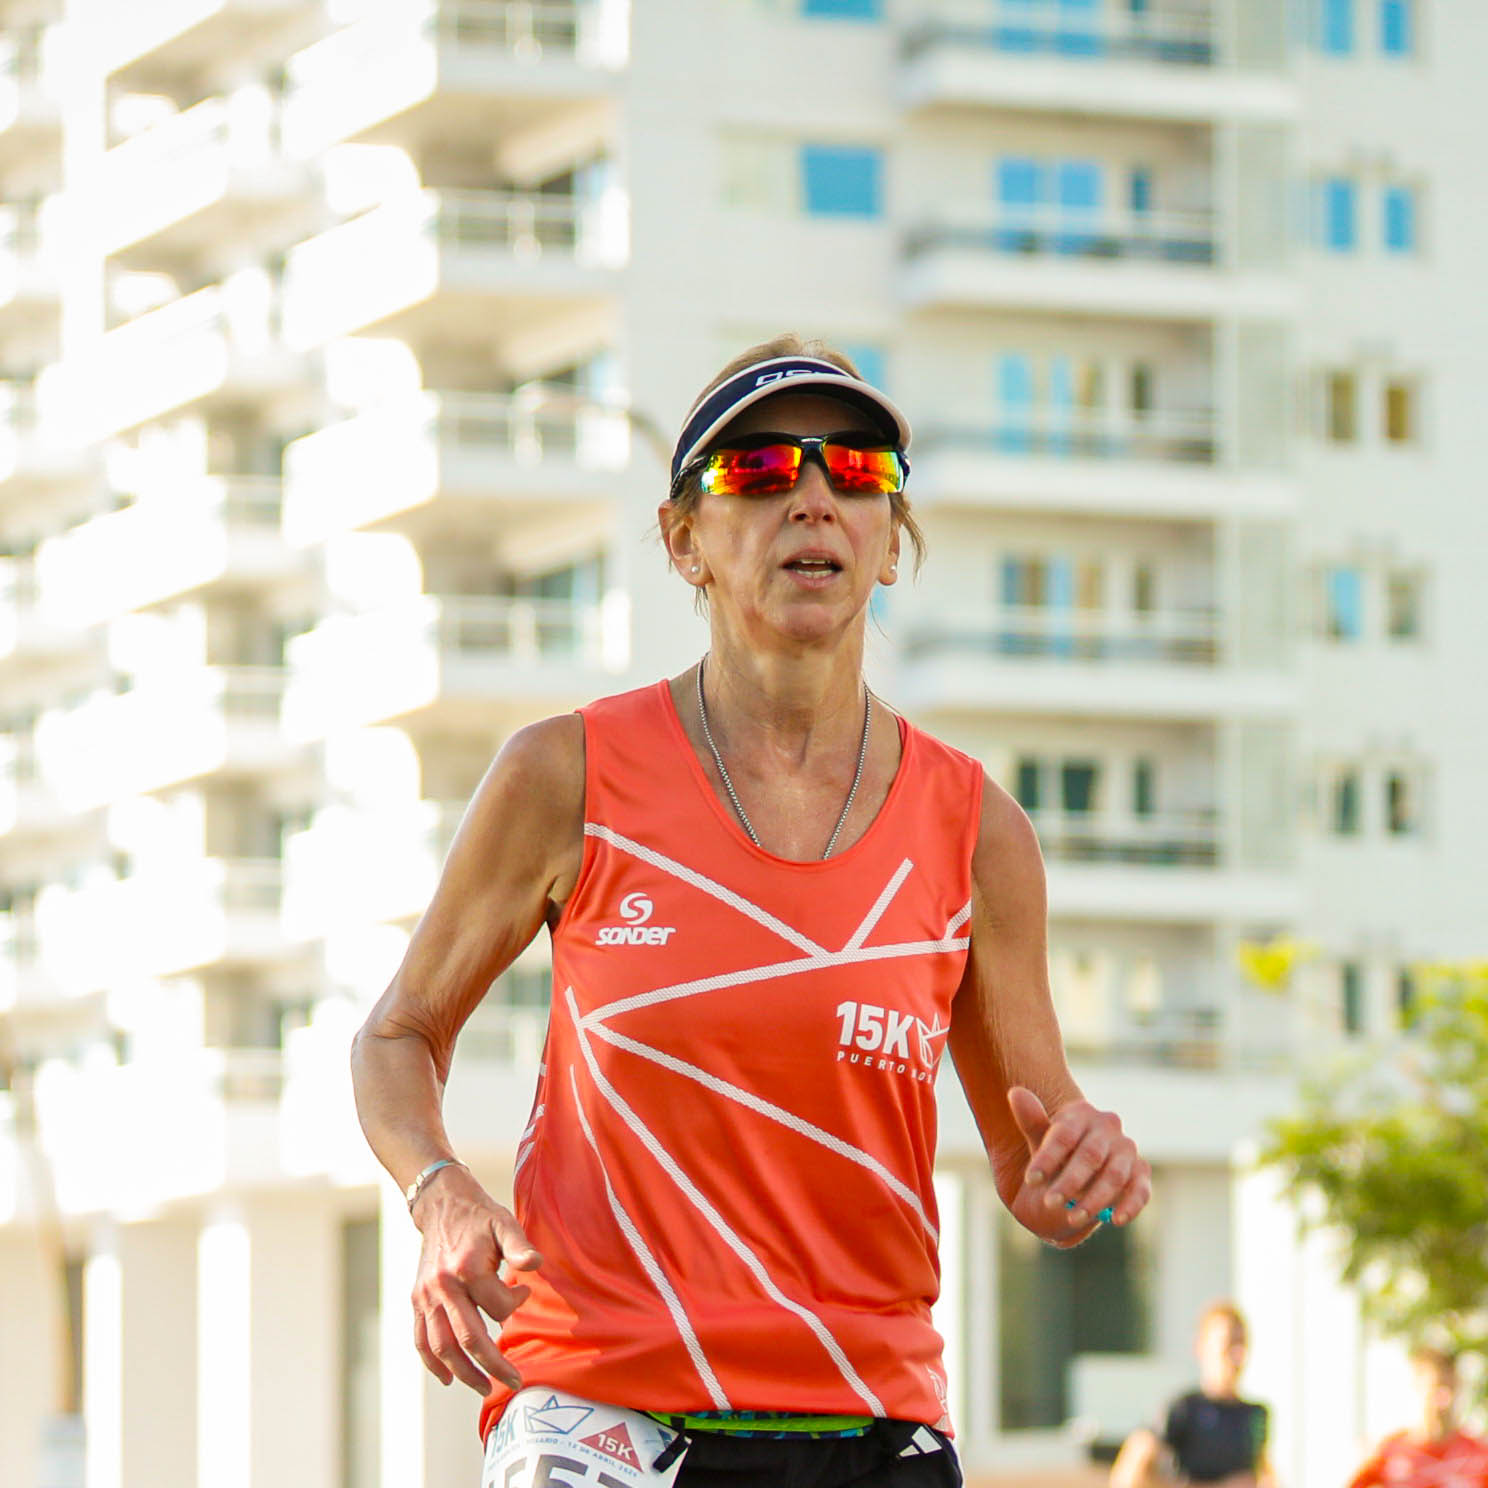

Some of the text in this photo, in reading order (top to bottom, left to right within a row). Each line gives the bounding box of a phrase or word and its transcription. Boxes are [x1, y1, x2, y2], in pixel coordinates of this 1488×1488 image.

[836, 1000, 915, 1059] 15K
[836, 1050, 906, 1074] PUERTO
[597, 1432, 633, 1461] 15K
